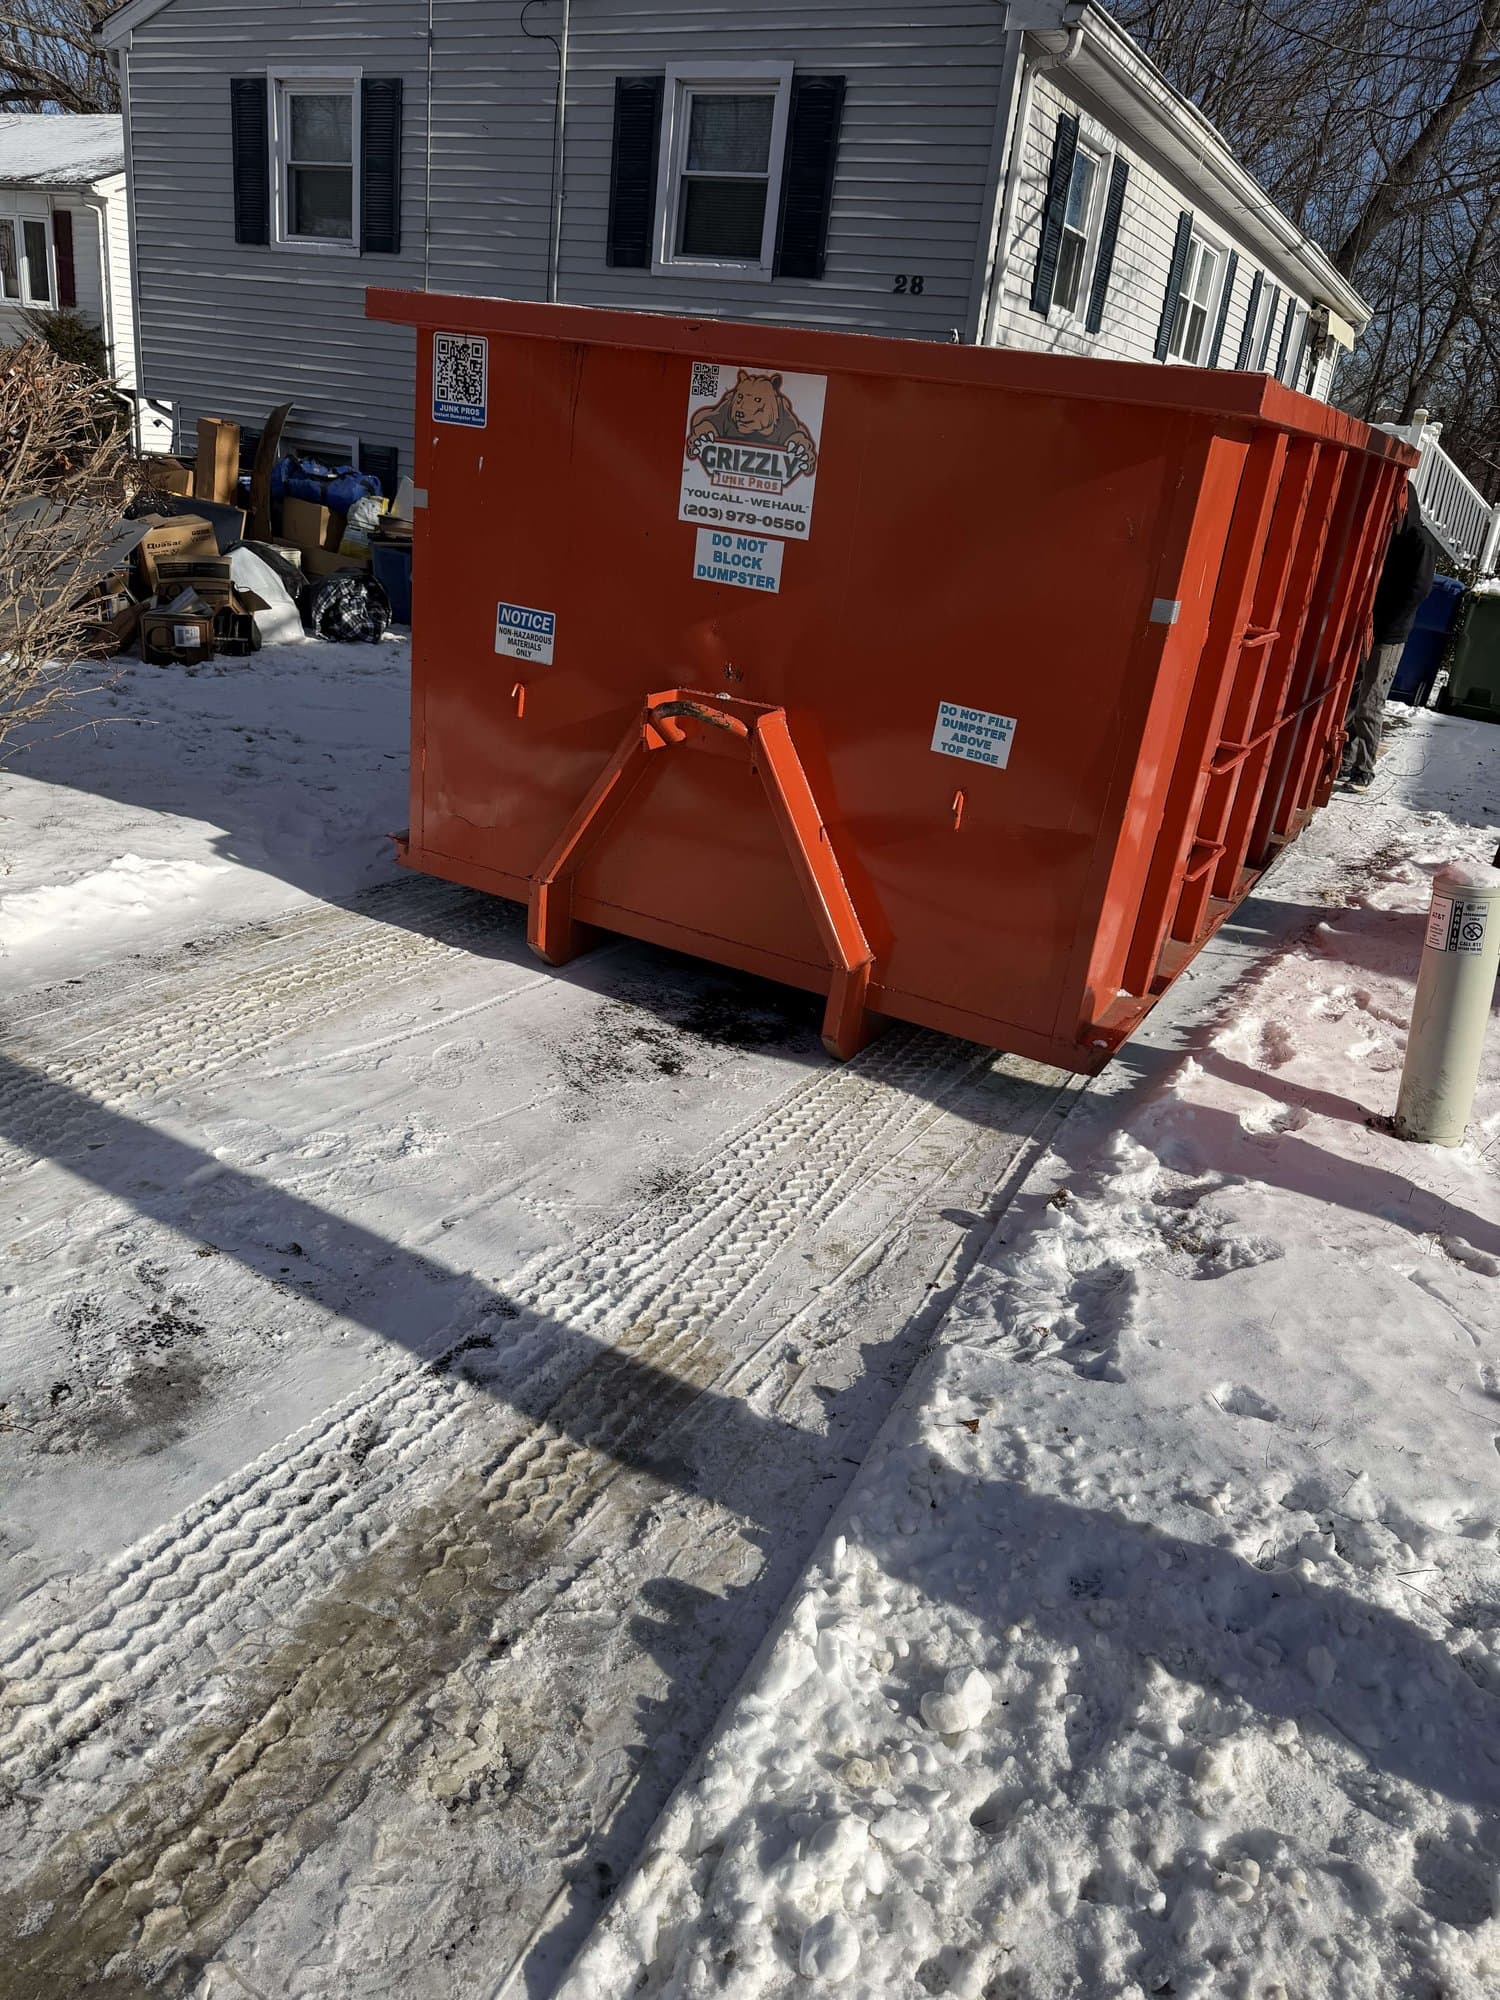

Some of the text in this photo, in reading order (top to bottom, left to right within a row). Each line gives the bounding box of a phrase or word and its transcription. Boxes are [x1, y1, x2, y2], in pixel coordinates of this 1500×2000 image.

[893, 274, 924, 295] 28
[440, 404, 480, 416] JUNK PROS
[701, 445, 800, 478] GRIZZLY
[711, 491, 744, 504] CALL
[750, 498, 770, 508] WE
[683, 504, 806, 532] (203) 979-0550
[711, 533, 768, 553] DO NOT
[712, 550, 763, 570] BLOCK
[697, 564, 776, 590] DUMPSTER
[501, 608, 552, 631] NOTICE
[498, 626, 552, 645] NON-HAZARDOUS
[507, 637, 542, 651] MATERIALS
[515, 647, 532, 658] ONLY
[940, 704, 1013, 730] DO NOT FILL
[941, 718, 1007, 741] DUMPSTER
[950, 733, 992, 750] ABOVE
[941, 742, 999, 764] TOP EDGE
[1450, 901, 1464, 950] WARNING
